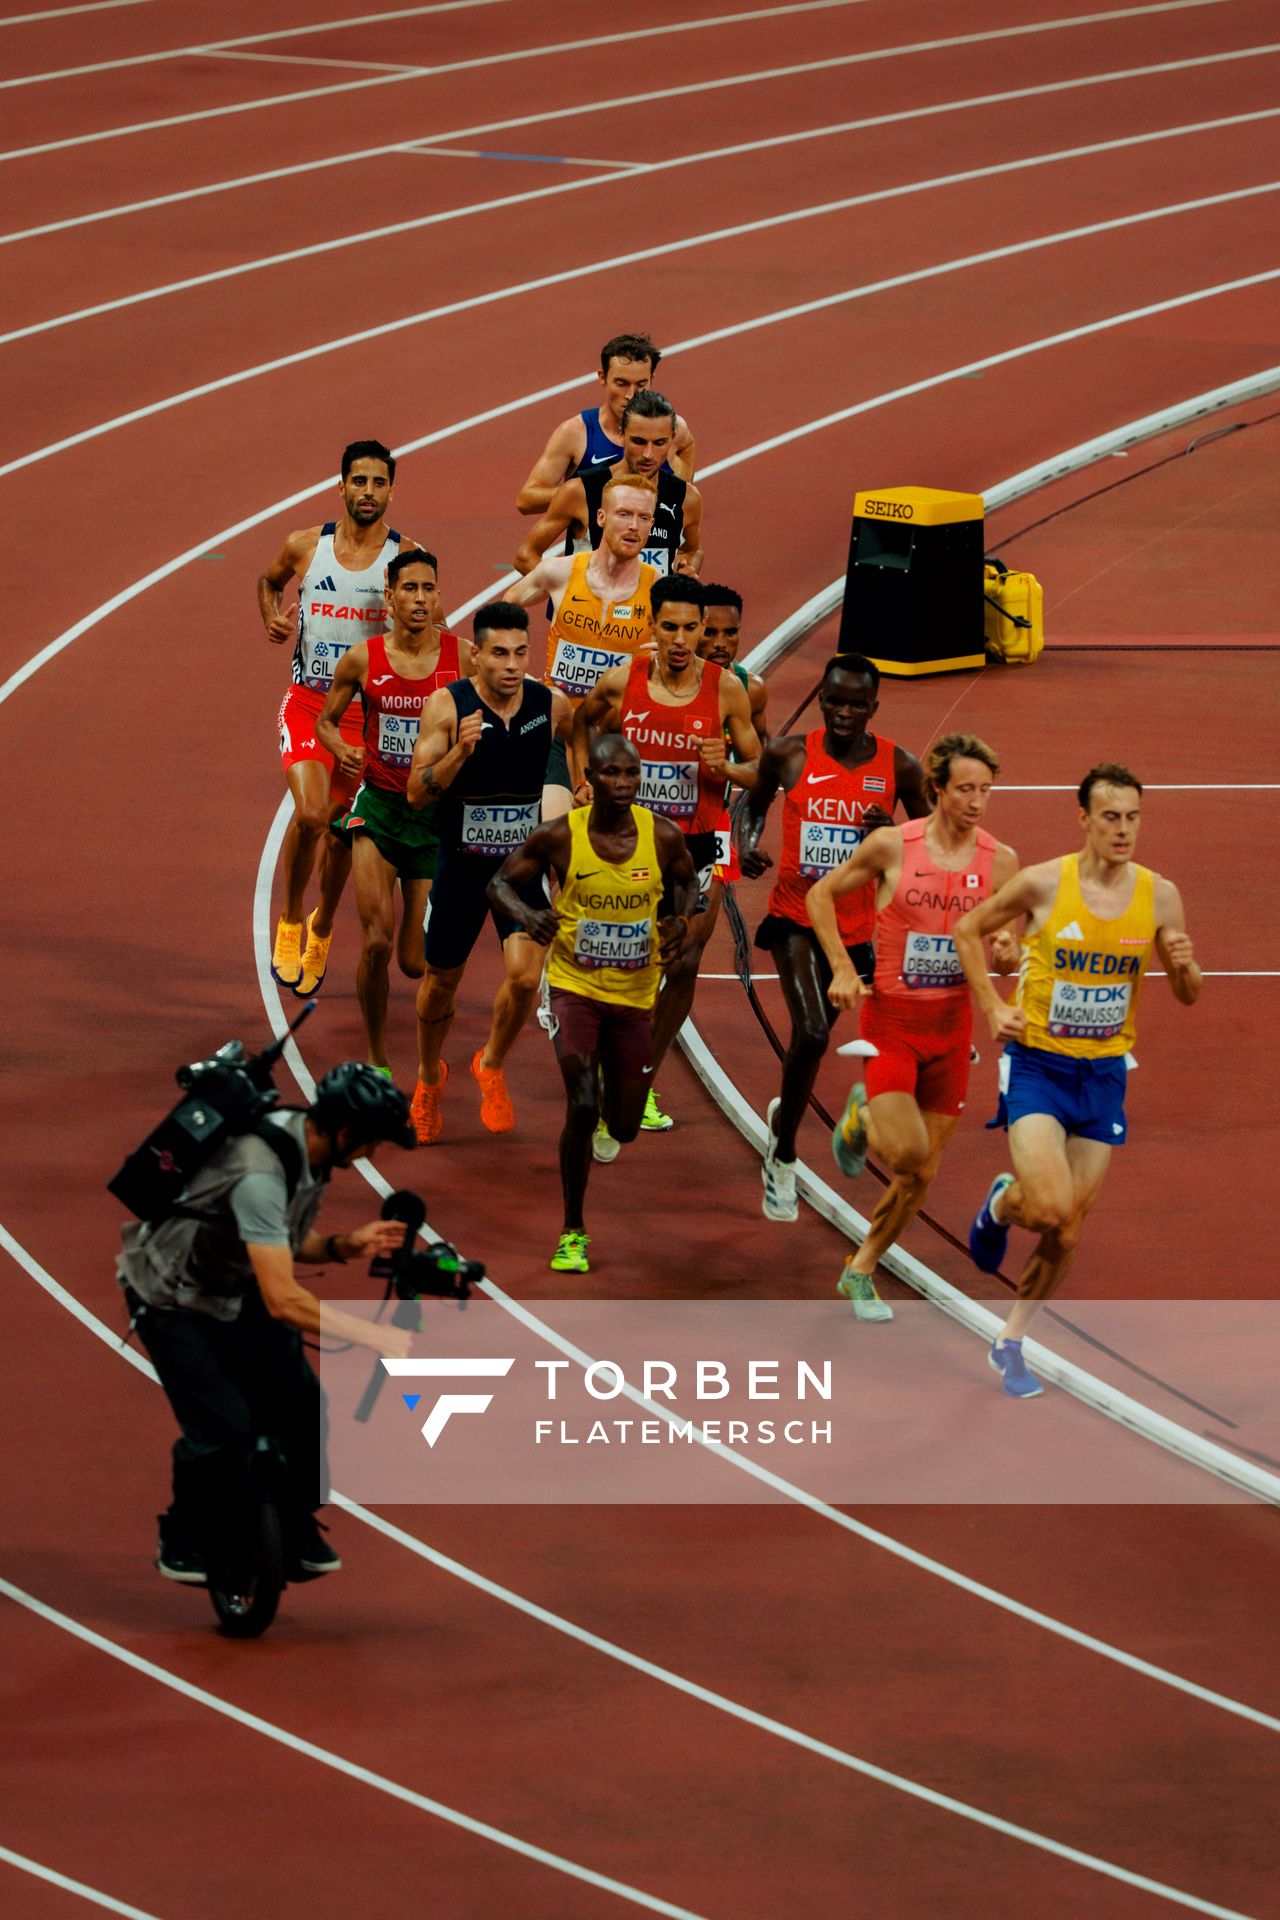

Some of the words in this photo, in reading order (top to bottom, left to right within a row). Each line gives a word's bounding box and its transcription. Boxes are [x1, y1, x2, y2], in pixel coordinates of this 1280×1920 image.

[864, 499, 914, 520] SEIKO
[563, 610, 643, 640] GERMANY
[576, 647, 625, 668] TDK
[520, 714, 548, 735] ANDORRA
[382, 735, 405, 752] BEN
[642, 763, 692, 780] TDK
[487, 805, 533, 823] TDK
[577, 892, 651, 910] UGANDA
[601, 921, 647, 938] TDK
[580, 938, 649, 957] CHEMUTAI
[1054, 948, 1142, 975] SWEDEN
[1078, 985, 1127, 1003] TDK
